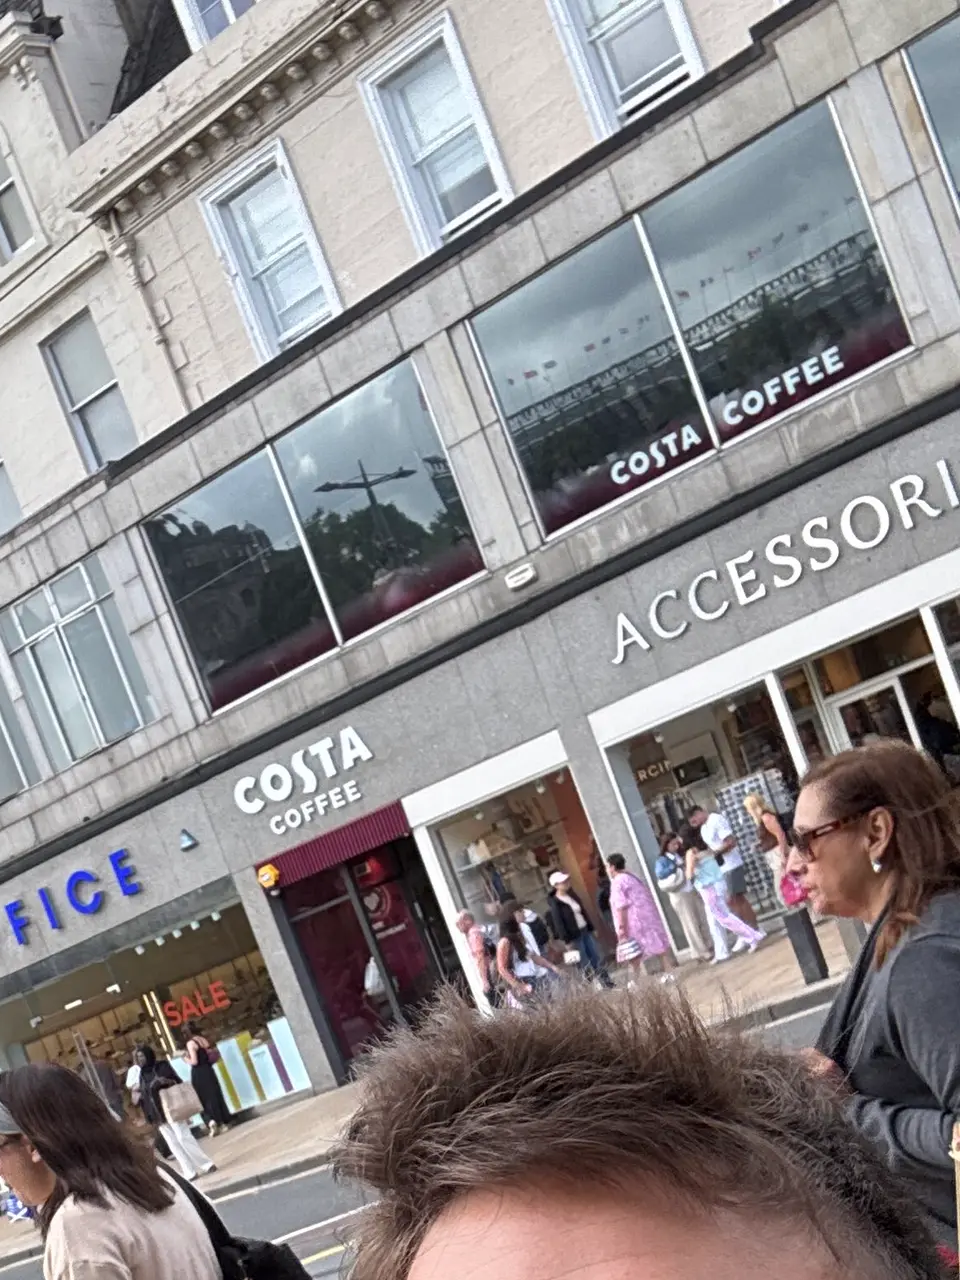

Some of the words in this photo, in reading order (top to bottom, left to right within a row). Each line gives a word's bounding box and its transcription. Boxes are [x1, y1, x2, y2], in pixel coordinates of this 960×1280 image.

[610, 424, 701, 485] COSTA
[722, 346, 844, 426] COFFEE
[611, 458, 960, 665] ACCESSORI
[233, 726, 374, 814] COSTA
[269, 780, 362, 835] COFFEE
[163, 981, 231, 1028] SALE
